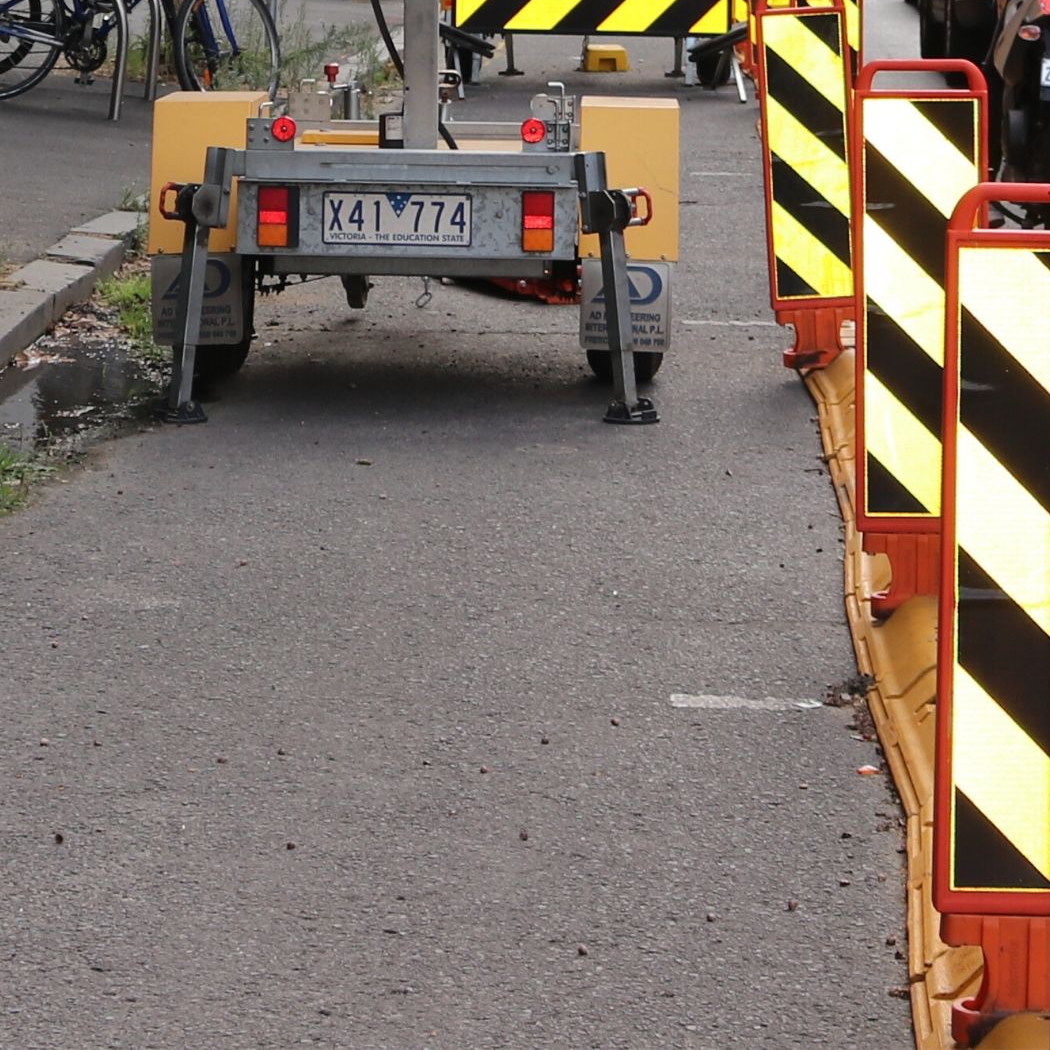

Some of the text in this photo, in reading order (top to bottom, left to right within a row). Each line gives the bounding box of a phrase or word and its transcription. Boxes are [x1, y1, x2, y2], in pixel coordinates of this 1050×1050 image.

[329, 199, 466, 234] X41 774
[329, 232, 367, 241] VICTORIA
[392, 234, 440, 242] EDUCATION
[442, 235, 464, 243] STATE
